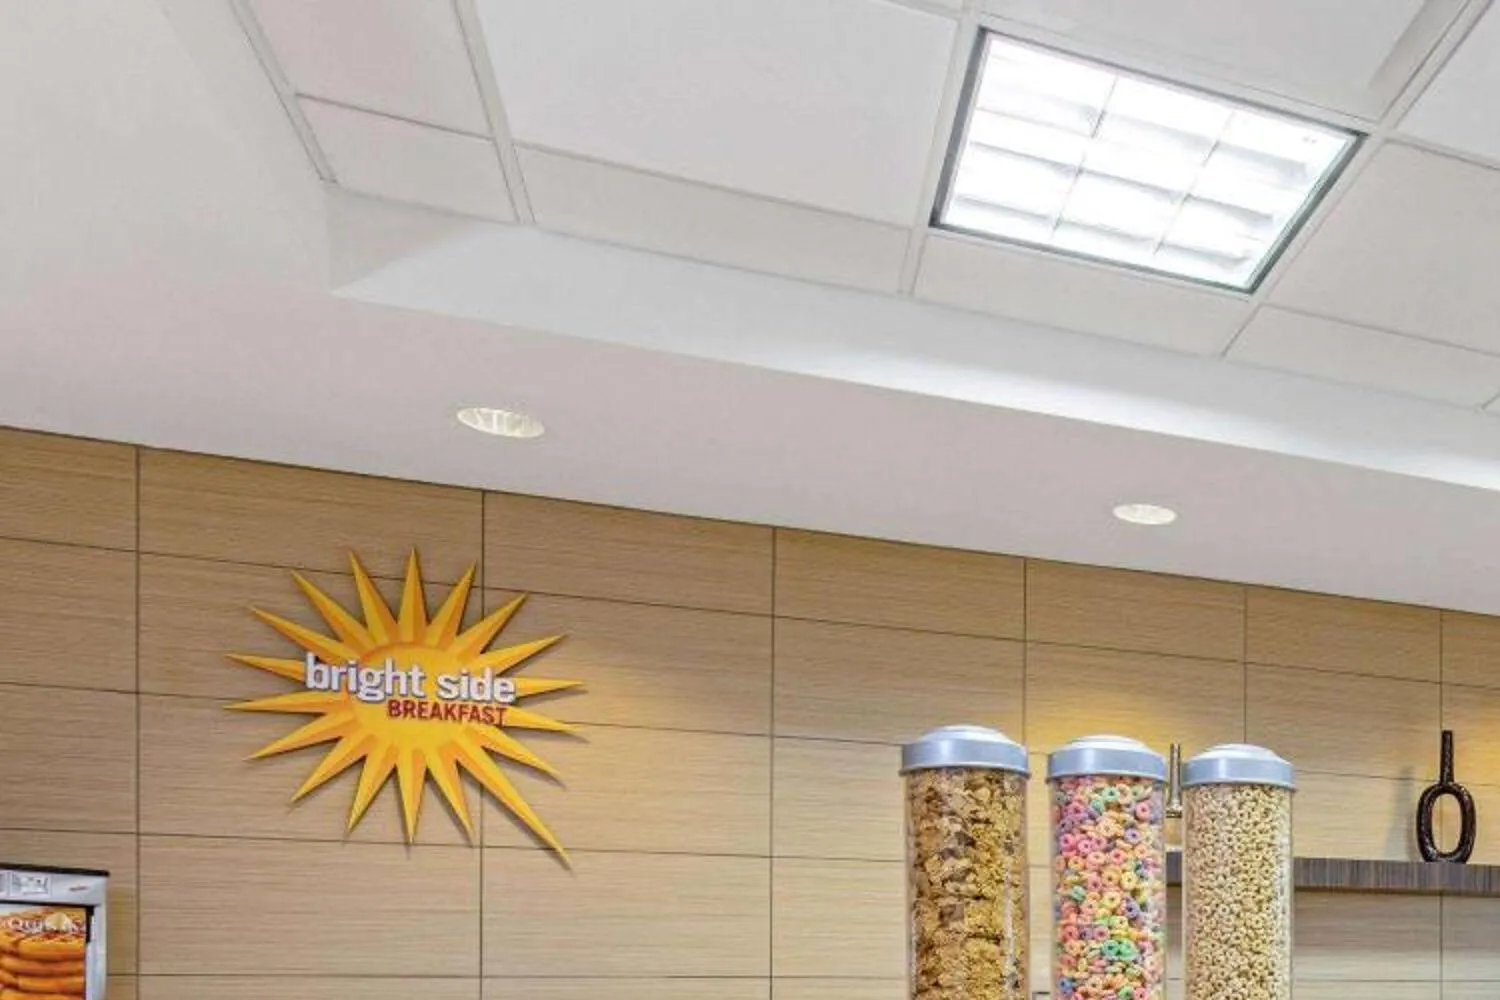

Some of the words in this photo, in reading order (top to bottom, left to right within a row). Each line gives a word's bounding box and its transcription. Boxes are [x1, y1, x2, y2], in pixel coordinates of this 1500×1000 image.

[305, 652, 427, 701] bright
[435, 668, 517, 703] side
[387, 700, 508, 727] BREAKFAST
